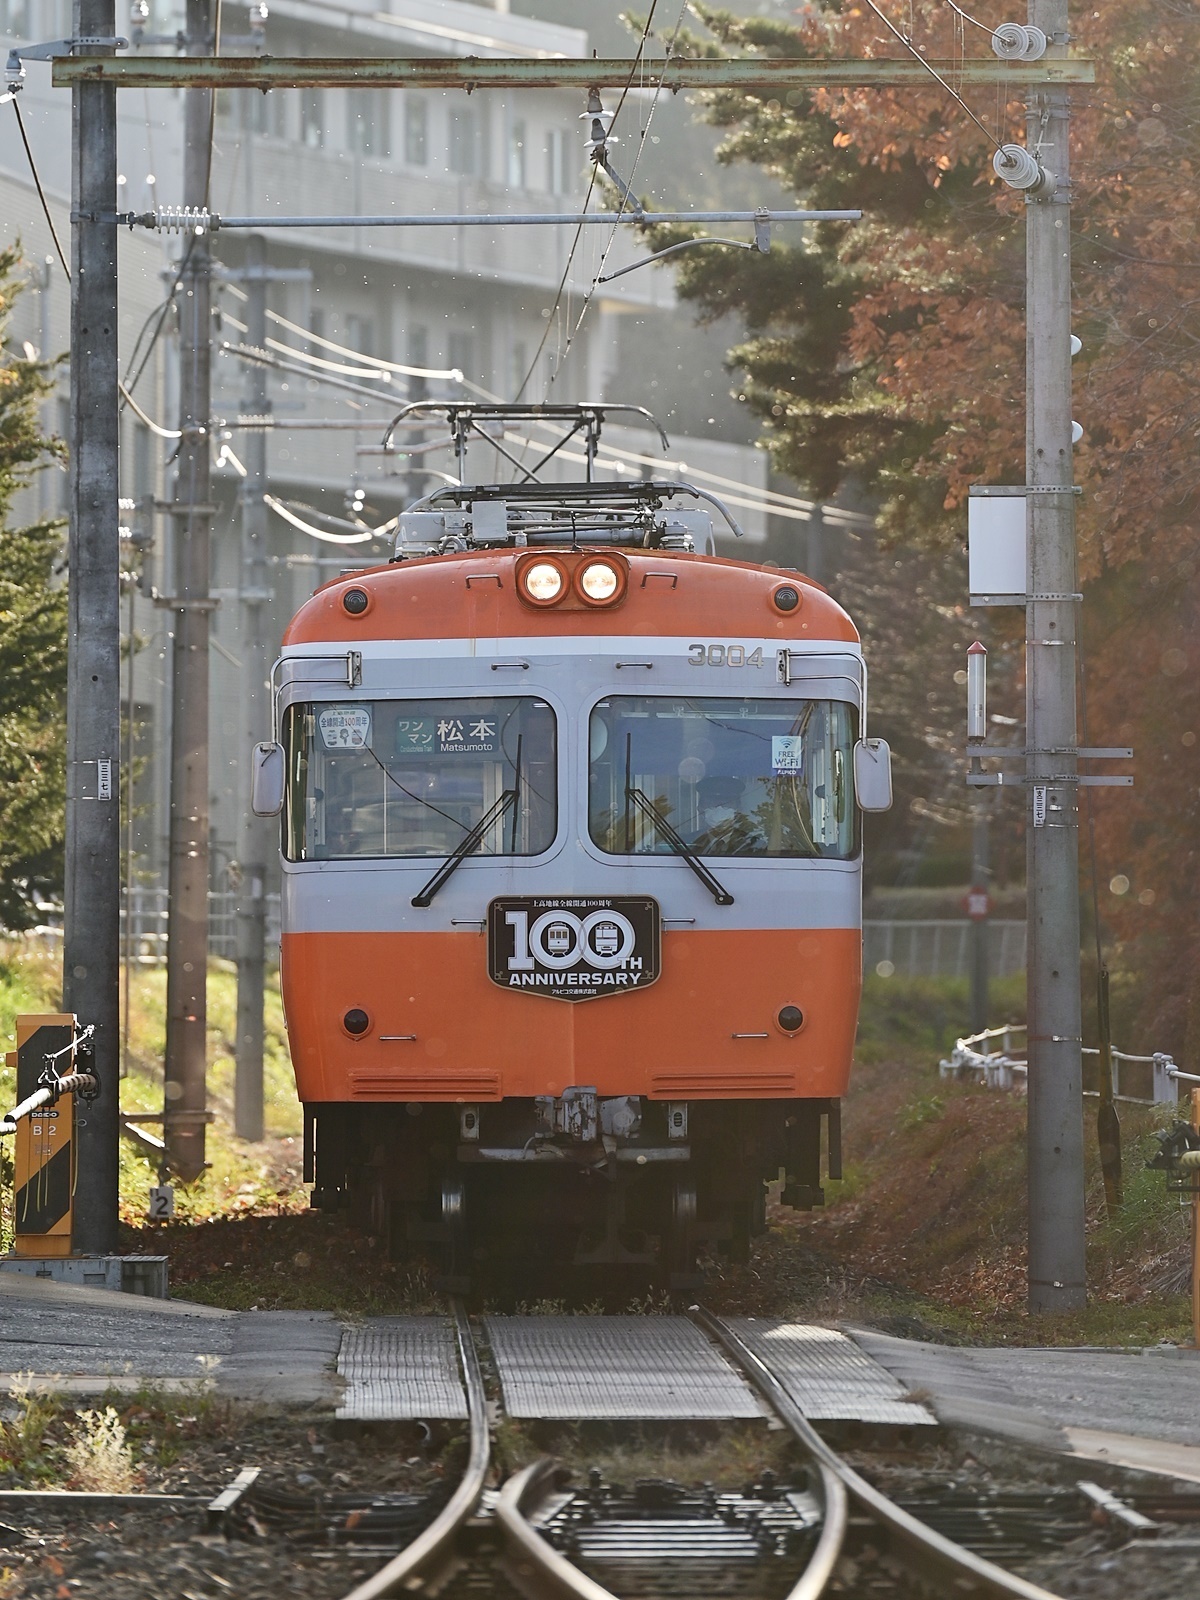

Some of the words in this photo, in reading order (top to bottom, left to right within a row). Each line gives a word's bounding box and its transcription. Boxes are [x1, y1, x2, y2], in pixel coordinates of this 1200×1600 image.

[687, 643, 764, 669] 3004
[399, 721, 424, 732] ワン
[437, 719, 496, 742] 松本
[408, 733, 433, 744] マン
[440, 743, 493, 752] Matsumoto
[778, 750, 796, 758] FREE
[509, 972, 642, 986] ANNIVERSARY
